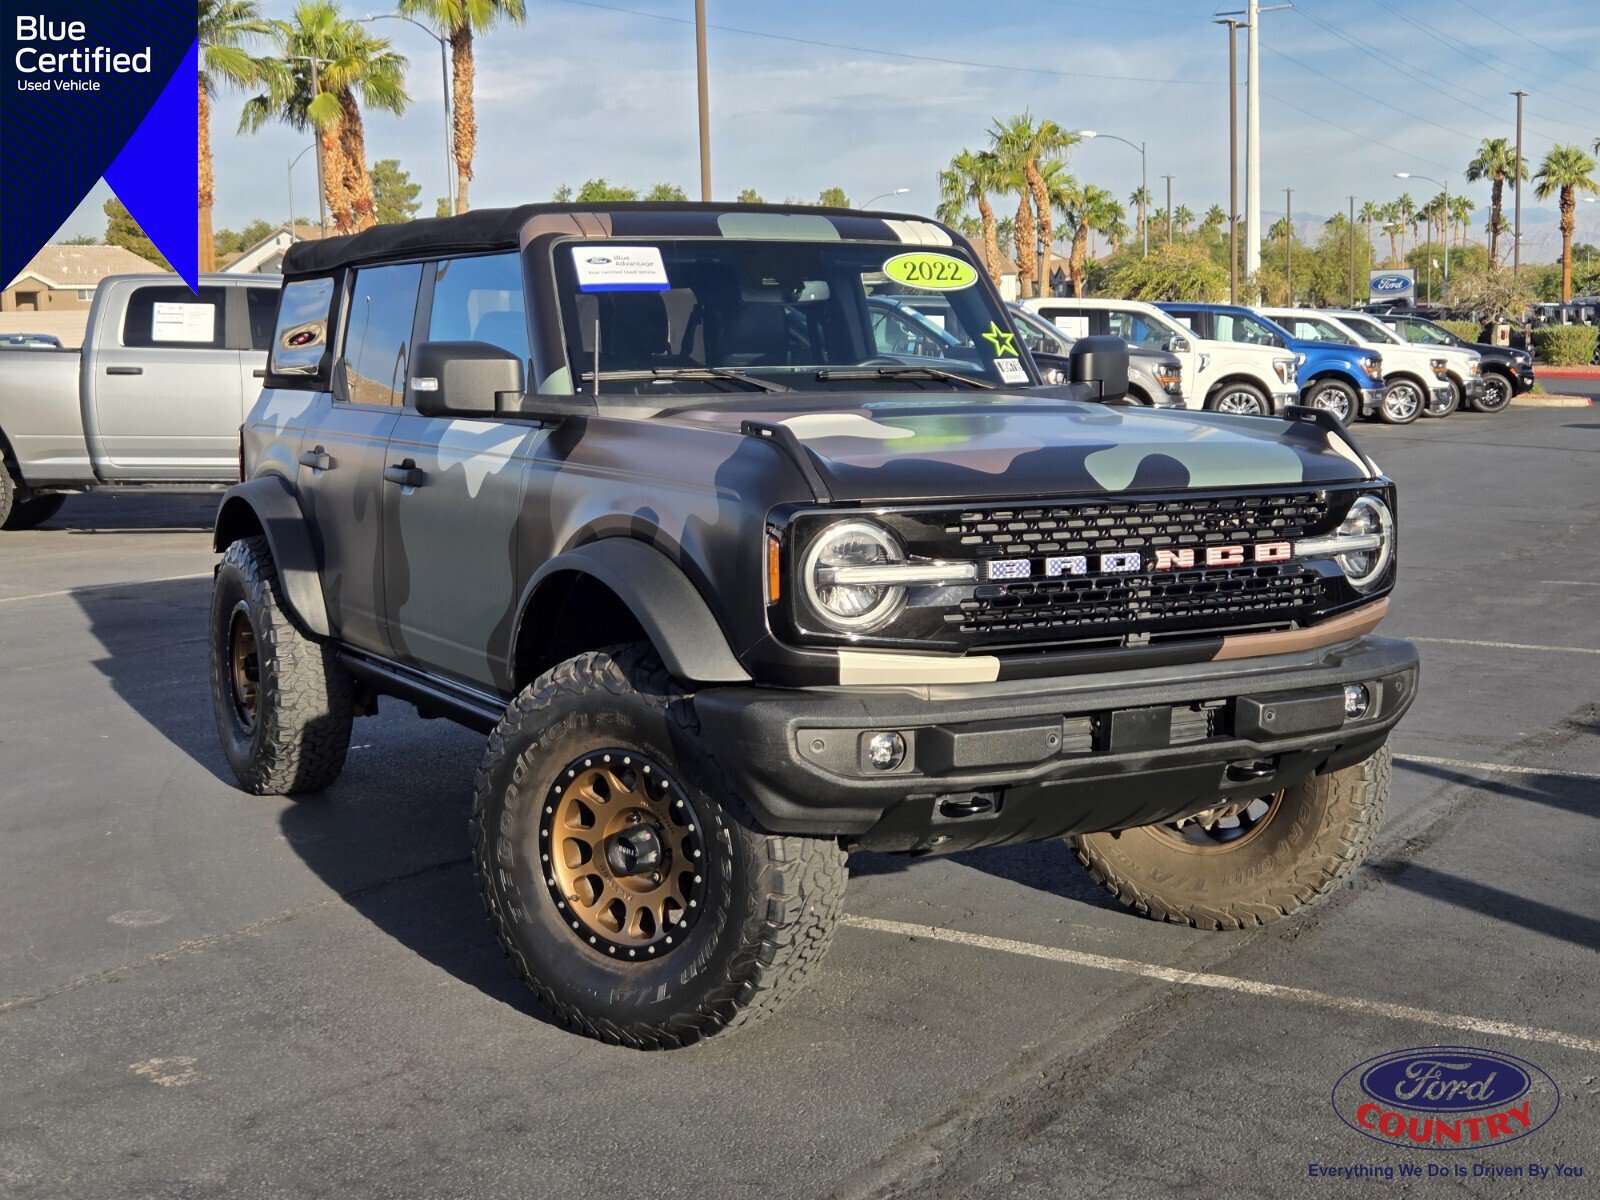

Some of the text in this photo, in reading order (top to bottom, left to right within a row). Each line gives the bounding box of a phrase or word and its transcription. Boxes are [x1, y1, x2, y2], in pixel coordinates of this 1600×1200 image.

[903, 261, 962, 281] 2022
[1377, 278, 1404, 290] Ford
[988, 541, 1291, 580] BRONCO
